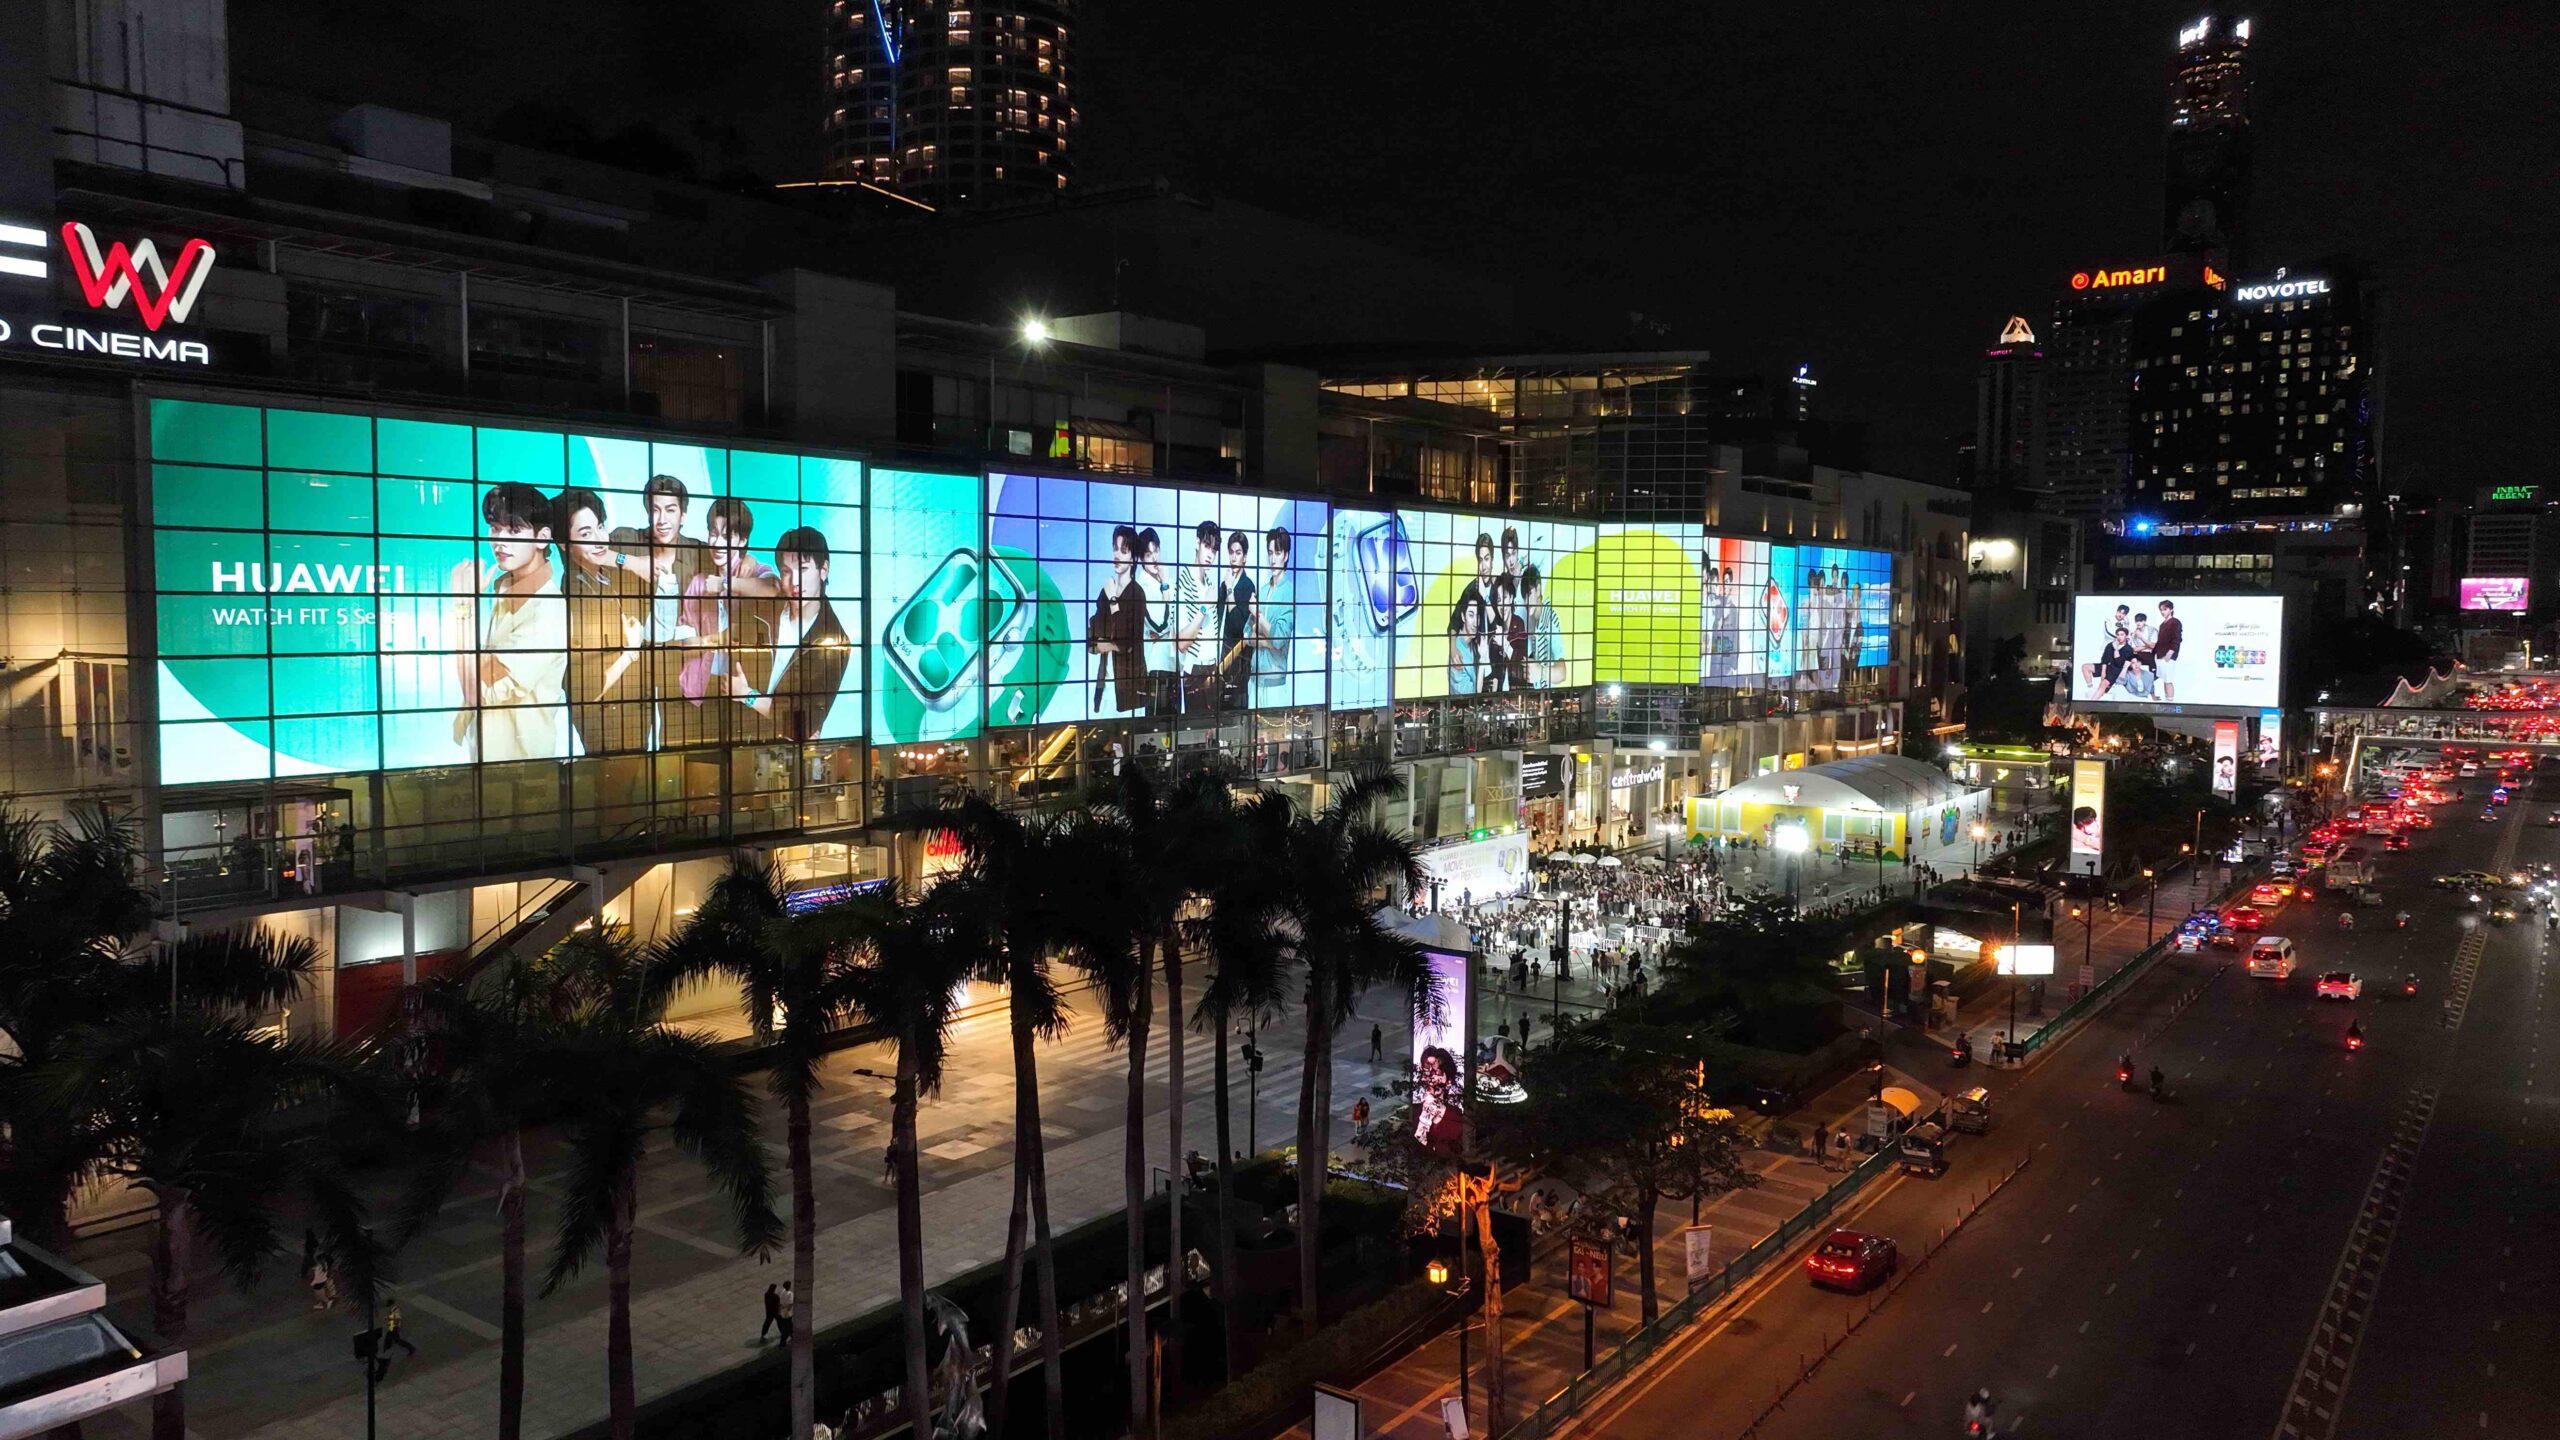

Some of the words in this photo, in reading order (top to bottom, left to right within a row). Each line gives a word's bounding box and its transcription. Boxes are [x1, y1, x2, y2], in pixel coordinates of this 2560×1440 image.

[2092, 266, 2166, 289] Amari
[2237, 280, 2331, 301] NOVOTEL
[30, 323, 210, 365] CINEMA
[2492, 492, 2533, 500] REGENT
[212, 561, 405, 593] HUAWEI
[1610, 590, 1681, 603] HUAWEI
[212, 608, 293, 626] WATCH
[300, 608, 330, 625] FIT
[336, 608, 348, 625] 5
